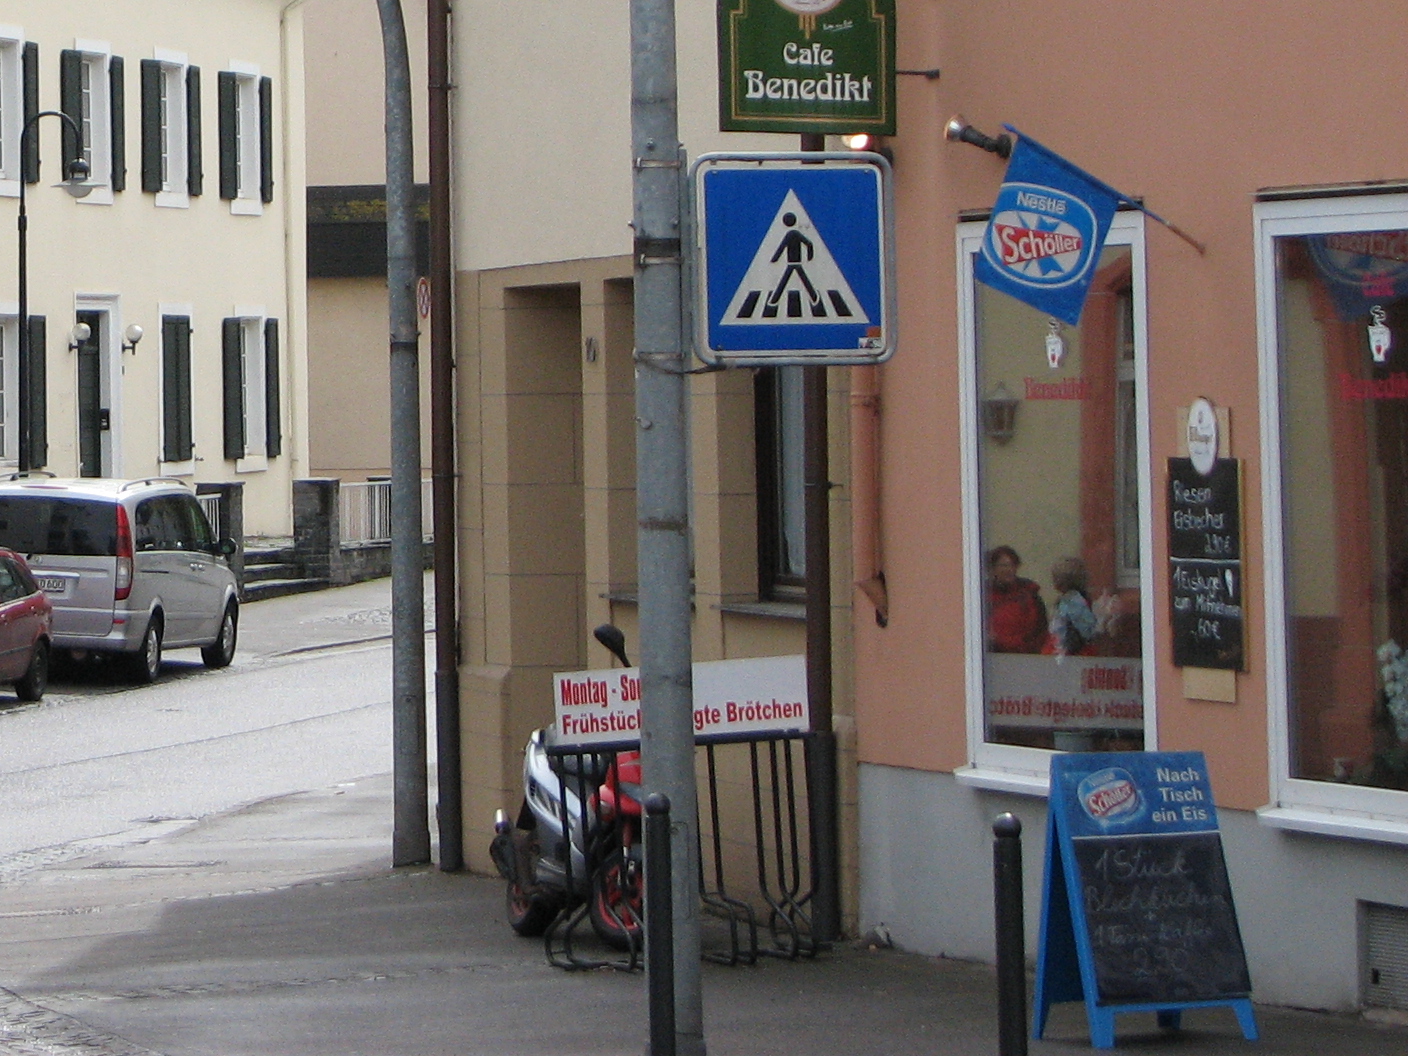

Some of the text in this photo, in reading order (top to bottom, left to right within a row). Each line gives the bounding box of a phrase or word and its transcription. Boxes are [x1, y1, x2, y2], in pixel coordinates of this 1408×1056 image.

[783, 42, 834, 65] Cafe
[744, 70, 872, 101] Benedikt
[1002, 227, 1079, 263] Schöller
[560, 678, 608, 708] Montag
[727, 700, 803, 724] Brötchen
[1156, 767, 1200, 783] Nach
[1159, 786, 1204, 802] Tisch
[1152, 806, 1208, 822] ein Eis
